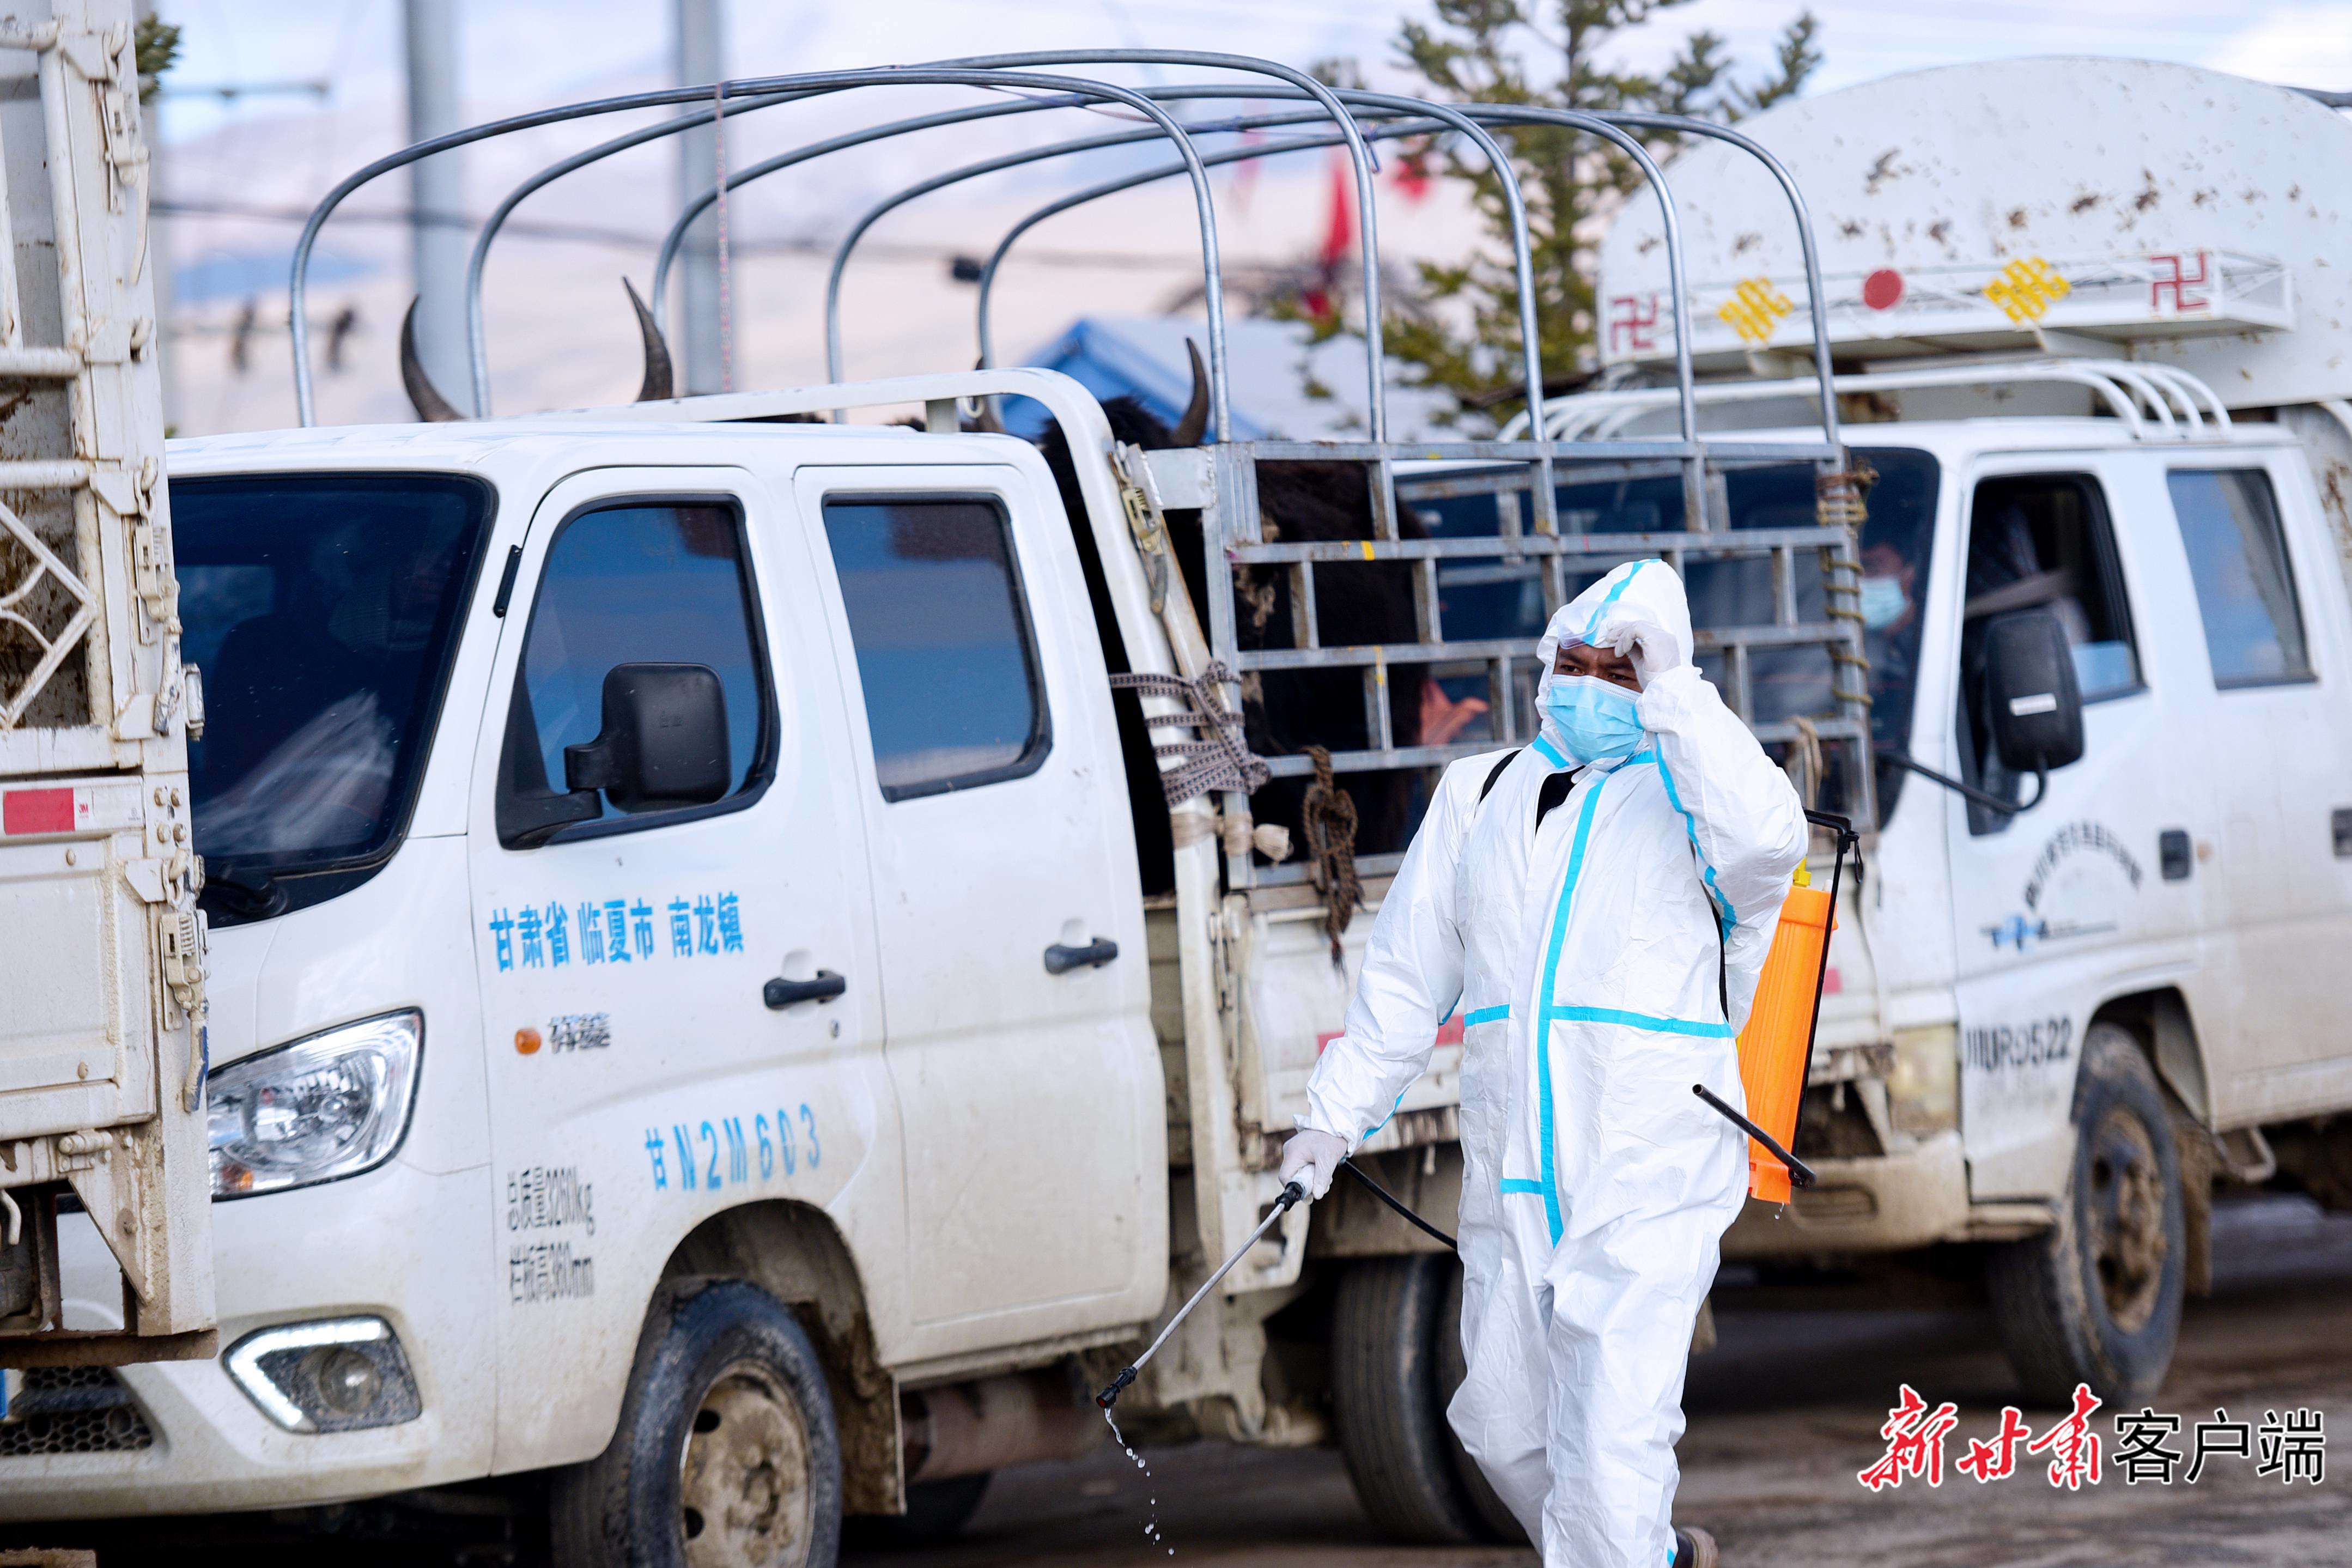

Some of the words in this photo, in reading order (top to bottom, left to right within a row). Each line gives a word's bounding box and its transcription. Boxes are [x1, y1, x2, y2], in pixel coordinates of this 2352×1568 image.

[489, 901, 570, 973] 甘肃省
[577, 897, 654, 965] 临夏市
[667, 891, 744, 958] 南龙镇
[645, 1102, 821, 1191] 甘N2M603
